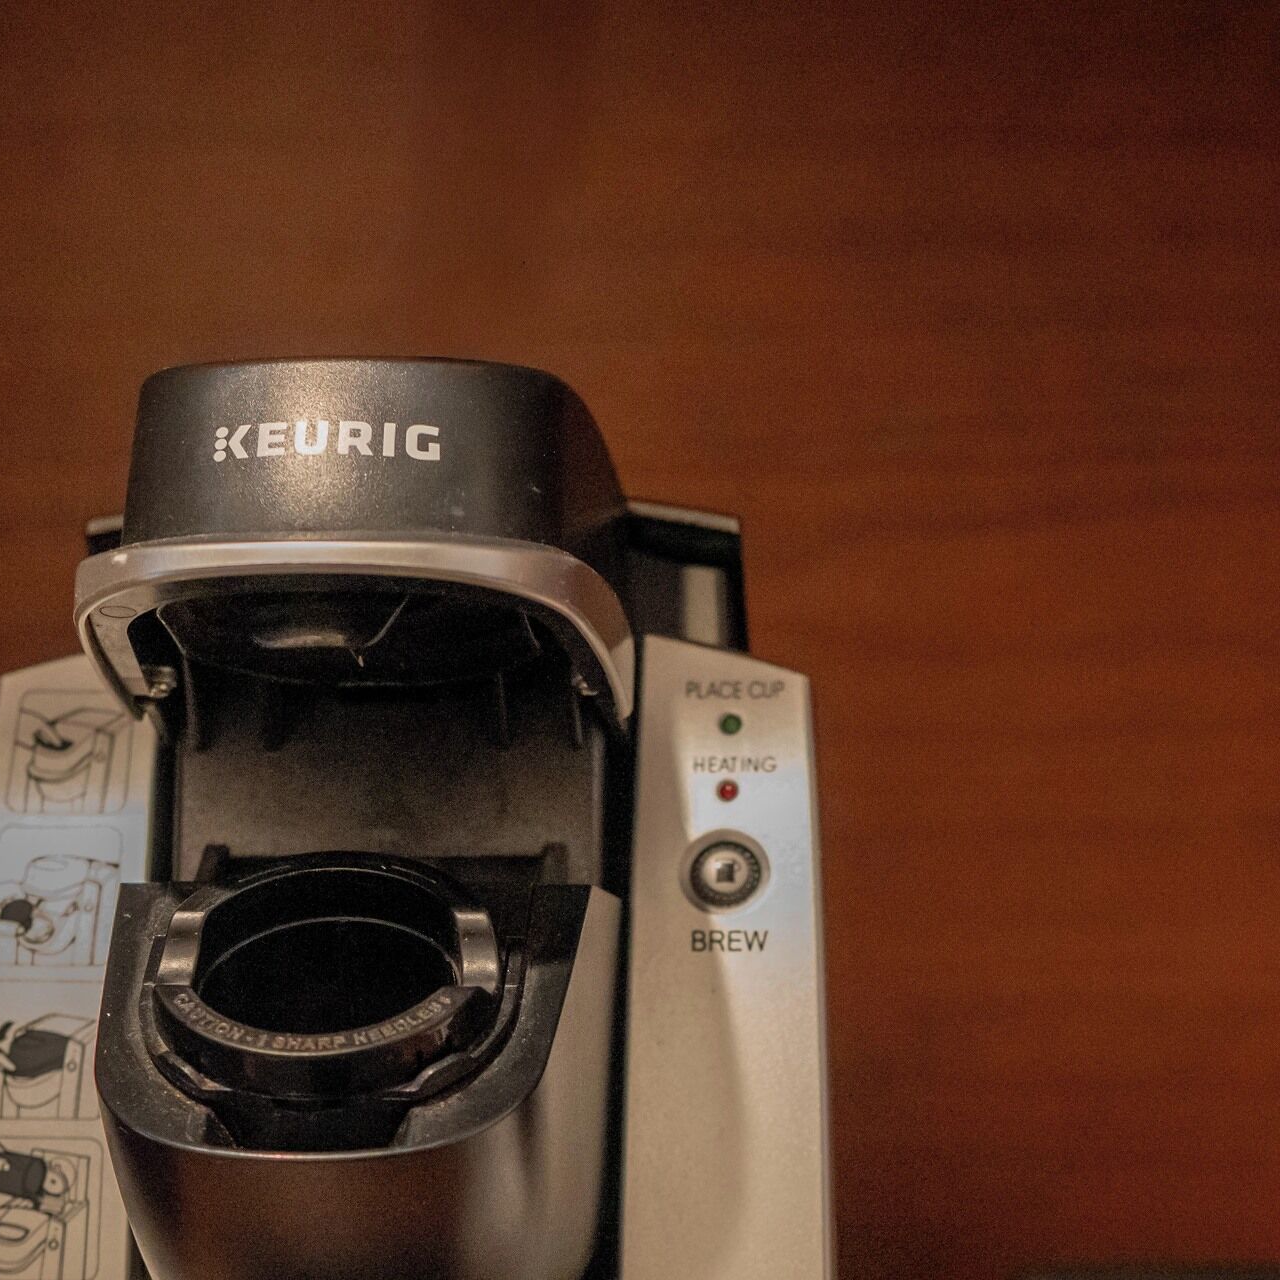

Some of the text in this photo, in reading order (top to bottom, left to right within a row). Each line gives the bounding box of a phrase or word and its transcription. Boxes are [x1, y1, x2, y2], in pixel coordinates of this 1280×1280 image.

[213, 420, 441, 462] KEURIG
[685, 680, 786, 700] PLACE CUP
[693, 755, 778, 774] HEATING
[691, 929, 769, 953] BREW
[271, 1035, 346, 1051] SHARP
